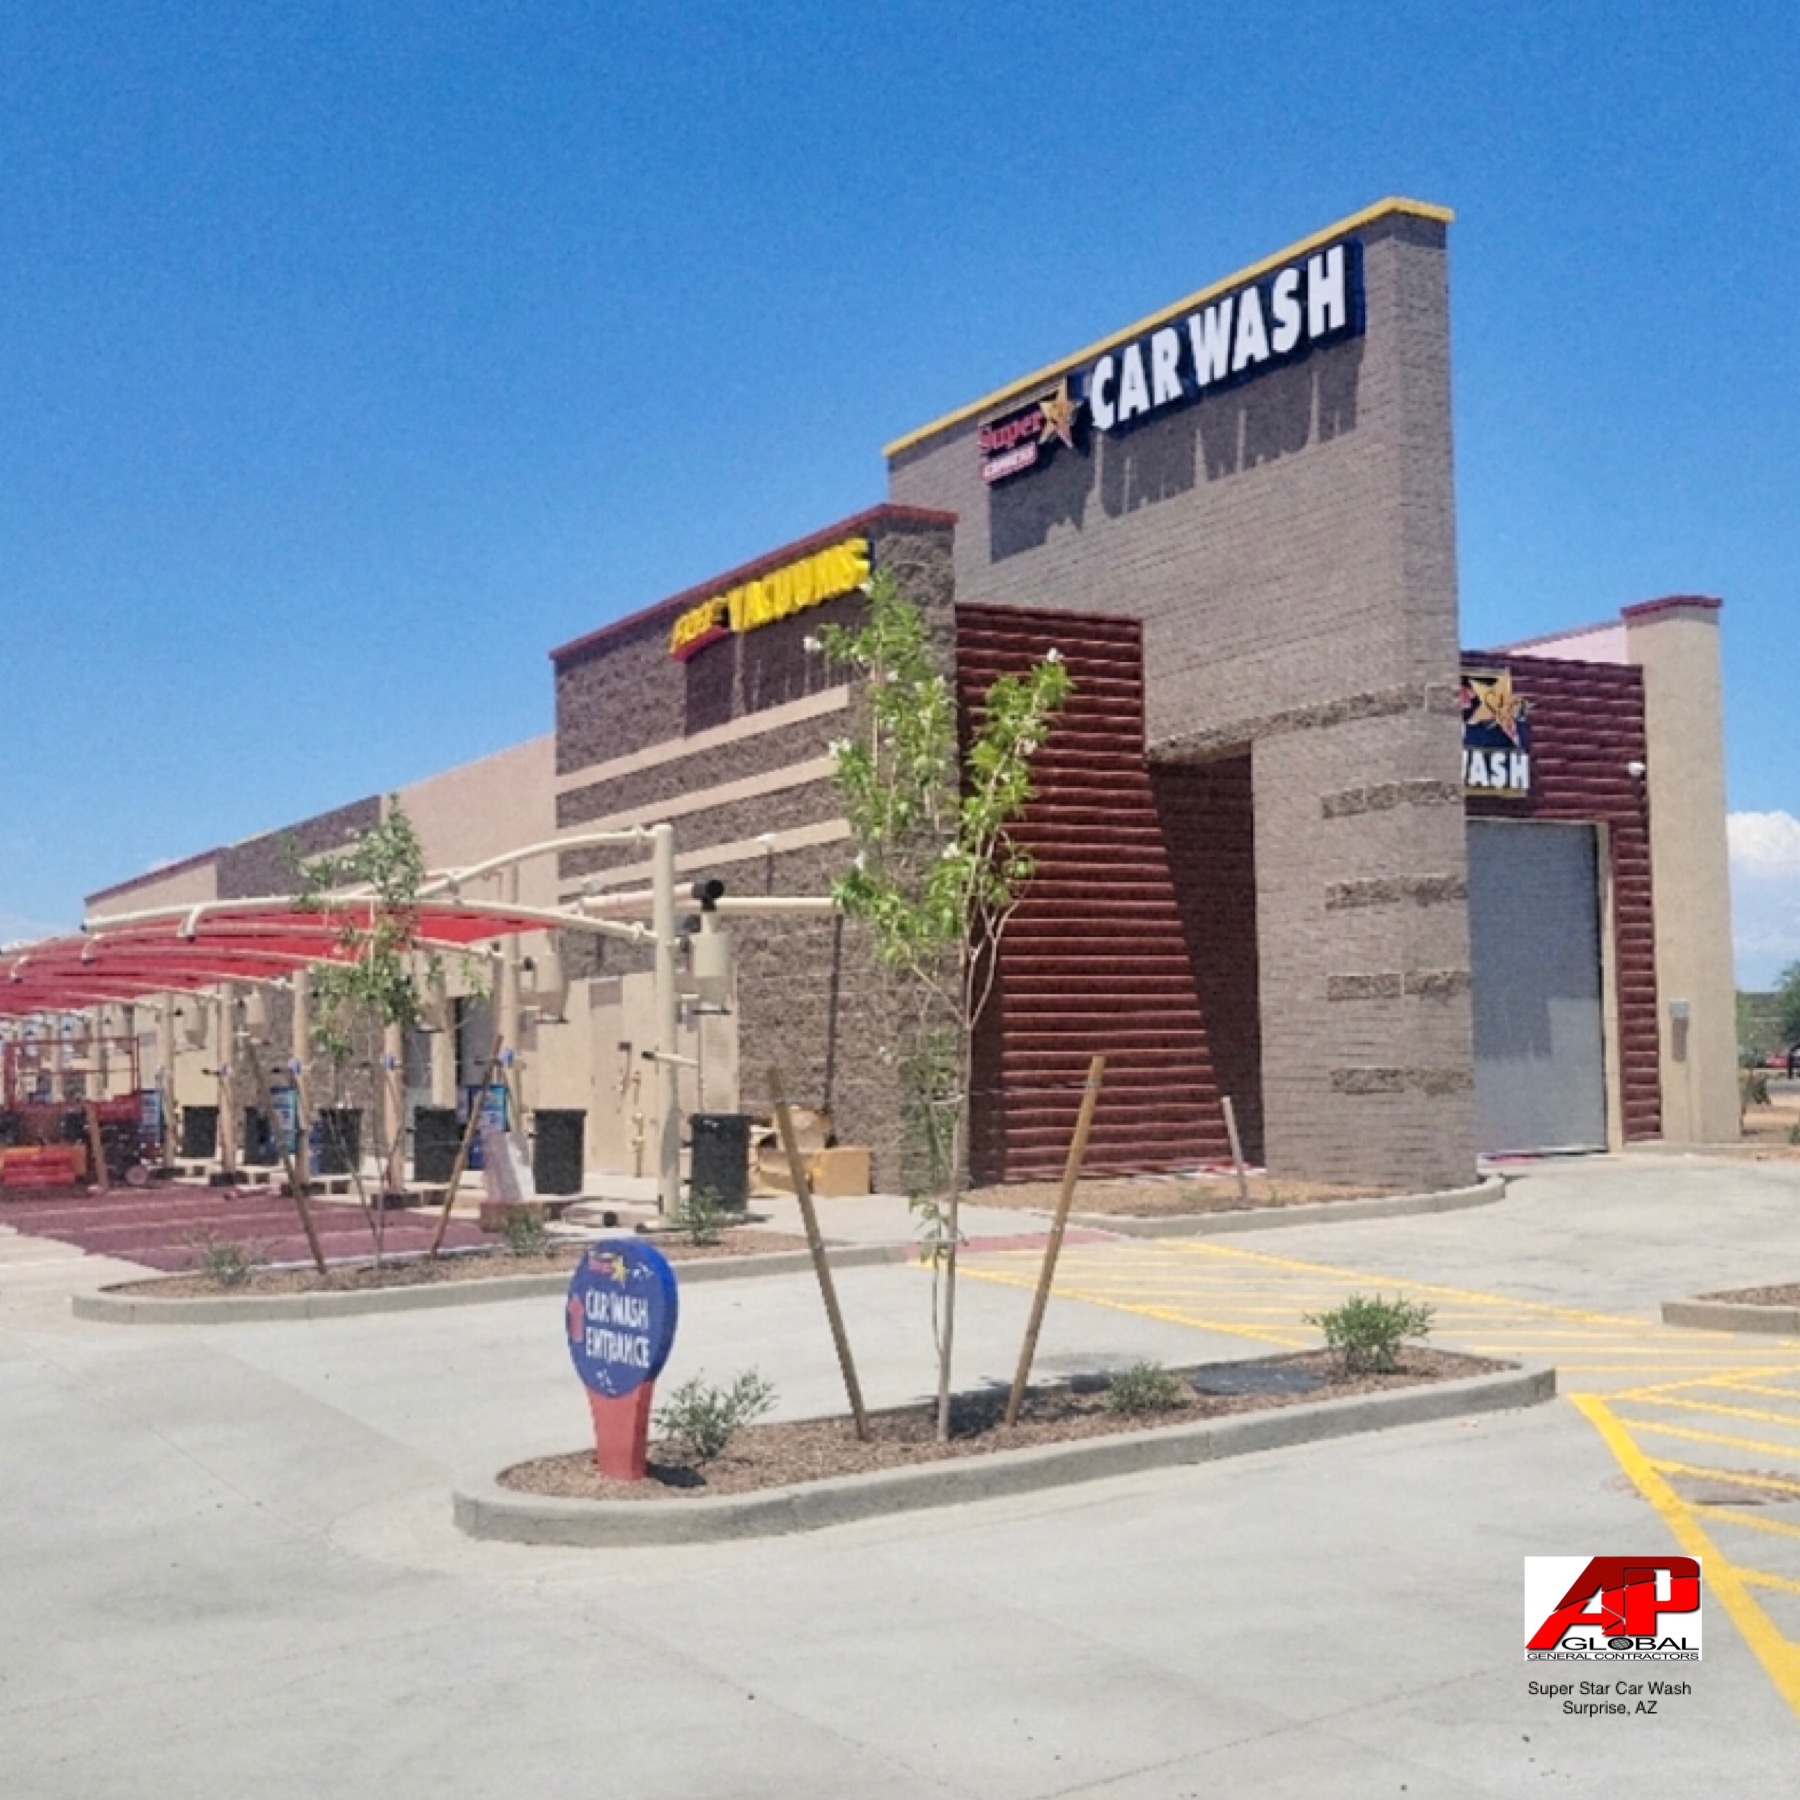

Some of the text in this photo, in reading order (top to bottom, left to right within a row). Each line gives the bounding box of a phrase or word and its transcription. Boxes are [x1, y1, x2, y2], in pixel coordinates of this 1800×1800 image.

[1090, 244, 1345, 431] CAR WASH
[1463, 750, 1529, 788] ASH
[585, 1290, 649, 1330] CAR WASH
[585, 1327, 650, 1369] ENTRANCE
